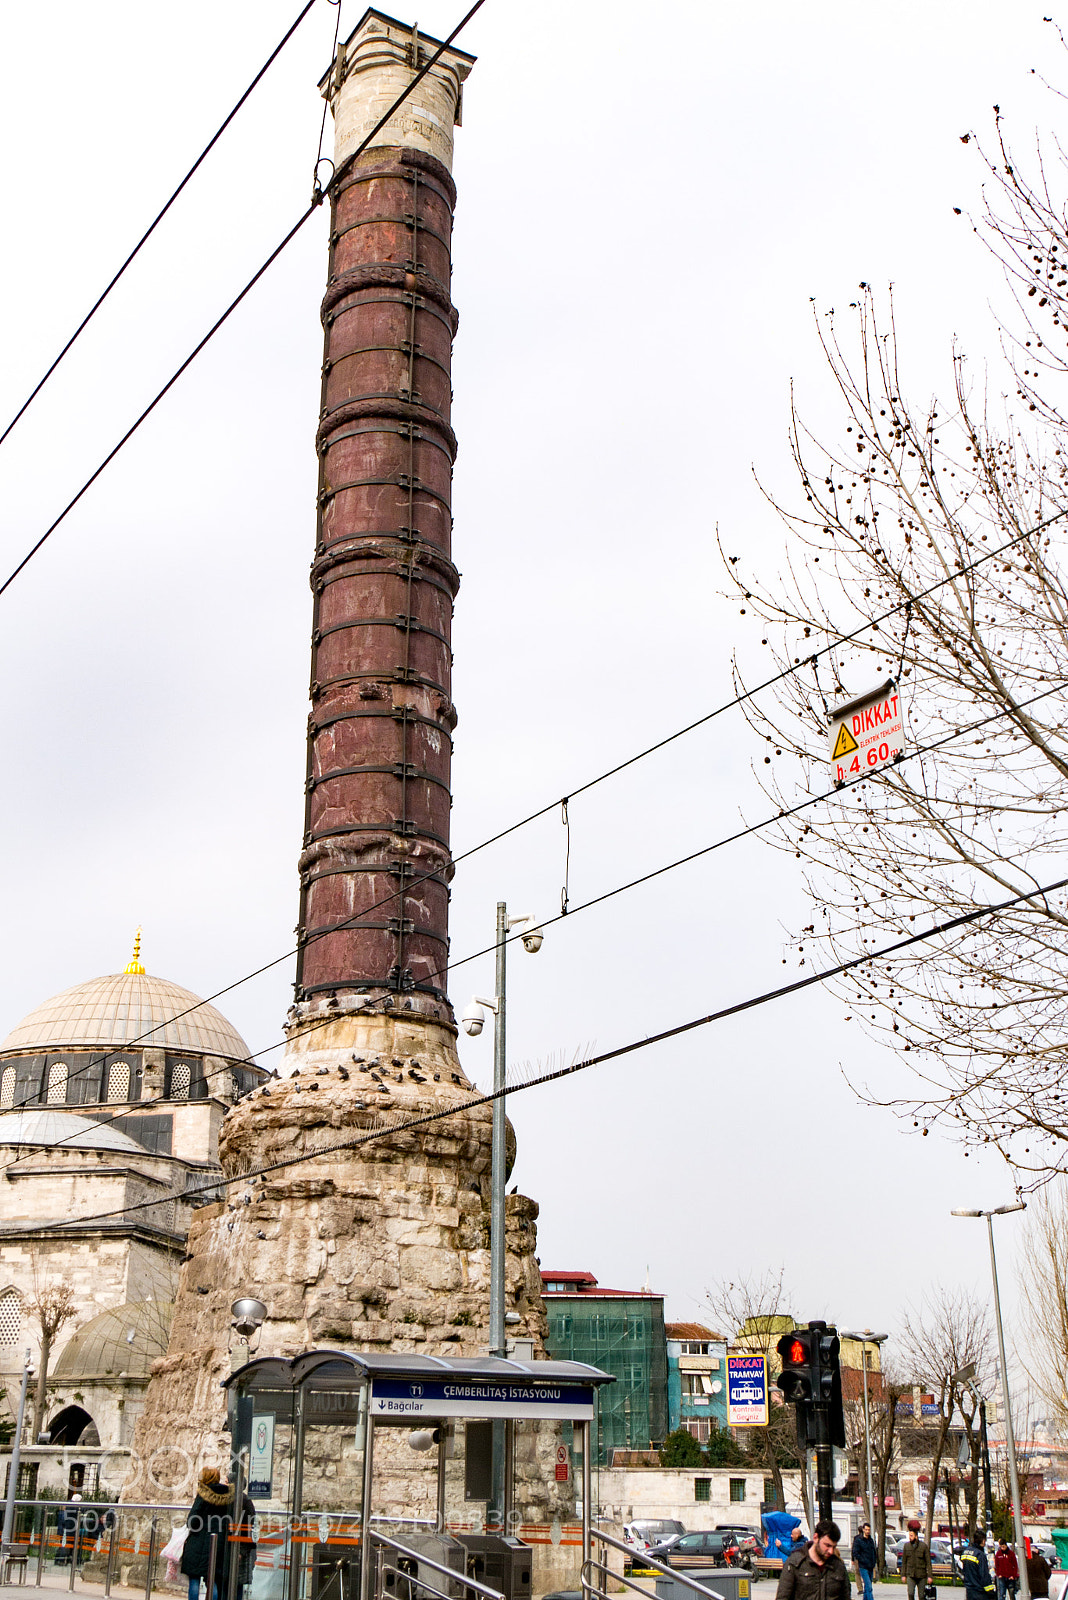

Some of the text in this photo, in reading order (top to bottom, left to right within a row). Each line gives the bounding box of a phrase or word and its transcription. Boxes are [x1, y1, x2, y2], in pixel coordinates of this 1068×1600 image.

[852, 695, 899, 737] DİKKAT
[729, 1358, 763, 1368] DİKKAT
[411, 1385, 561, 1400] T1 ÇEMBERLİTAŞ İSTASYONU
[387, 1401, 424, 1412] Bağcılar
